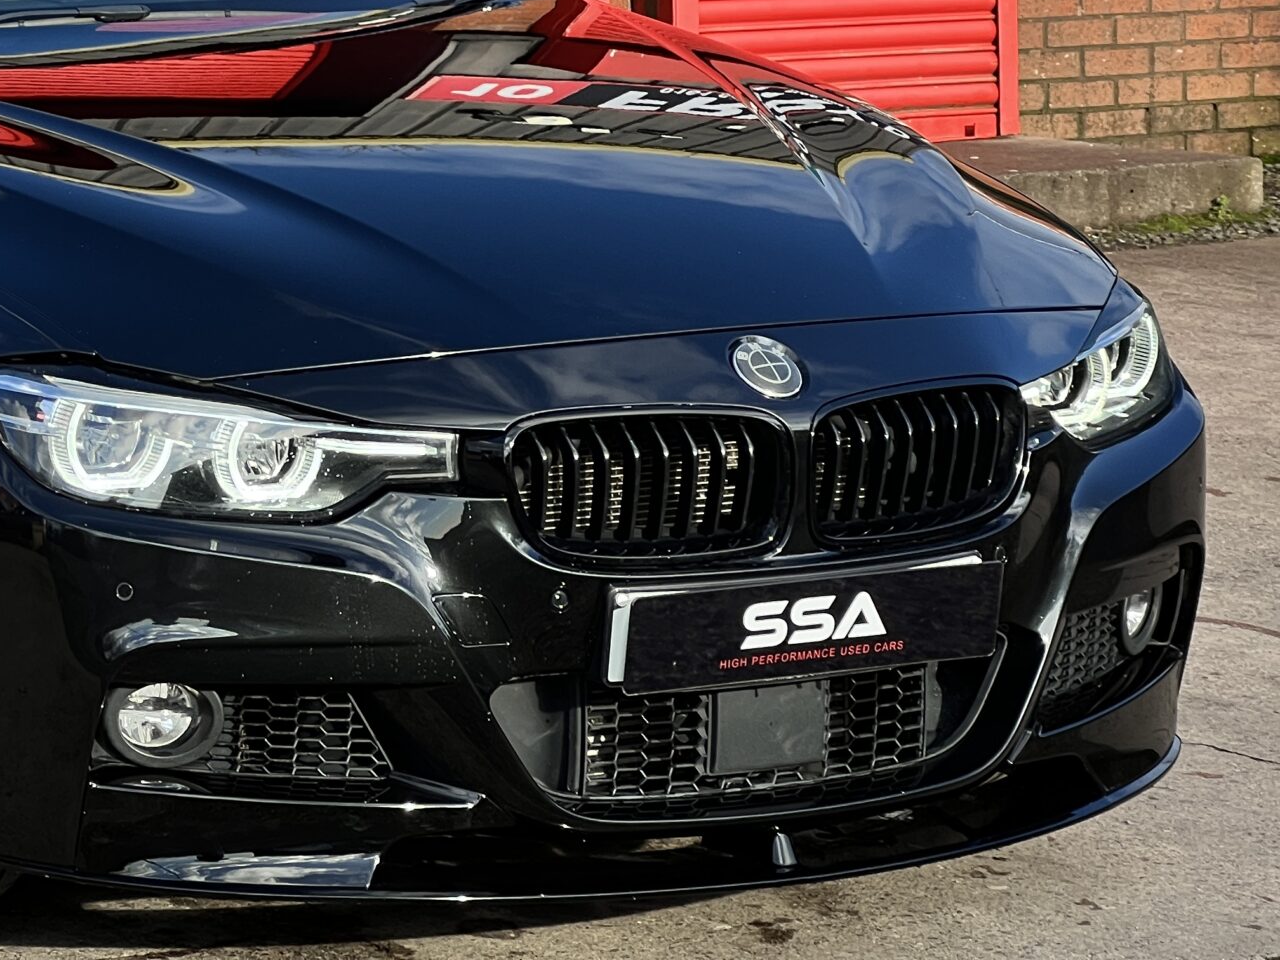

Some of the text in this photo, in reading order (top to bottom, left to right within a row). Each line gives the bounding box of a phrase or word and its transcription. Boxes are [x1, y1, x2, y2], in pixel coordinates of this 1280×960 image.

[740, 590, 887, 650] SSA
[719, 640, 904, 670] HIGH PERFORMANCE USED CARS
